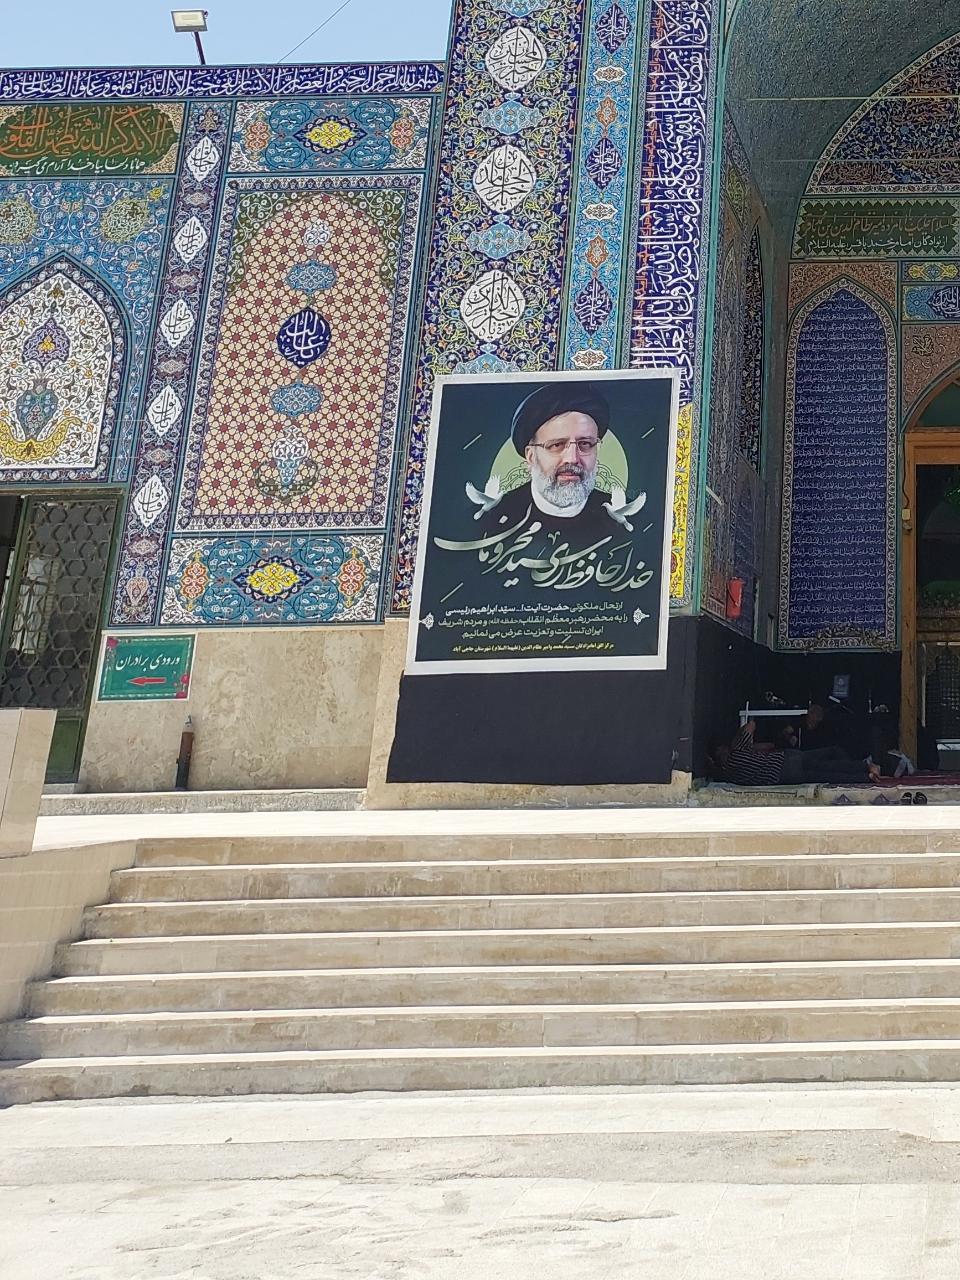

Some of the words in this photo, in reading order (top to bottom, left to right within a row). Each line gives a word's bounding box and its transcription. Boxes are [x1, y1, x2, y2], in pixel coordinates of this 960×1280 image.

[471, 604, 498, 615] ابراهیم
[541, 603, 569, 613] حضرت
[570, 602, 599, 613] ملکوتی
[600, 602, 623, 611] ارتحال
[568, 615, 587, 624] رهبر
[586, 614, 613, 624] محضر
[501, 629, 522, 638] عرض
[524, 628, 549, 638] تعزیت
[555, 627, 585, 637] تسلیت
[585, 626, 603, 636] ایران
[115, 654, 149, 672] برادران
[149, 653, 180, 670] ورودی
